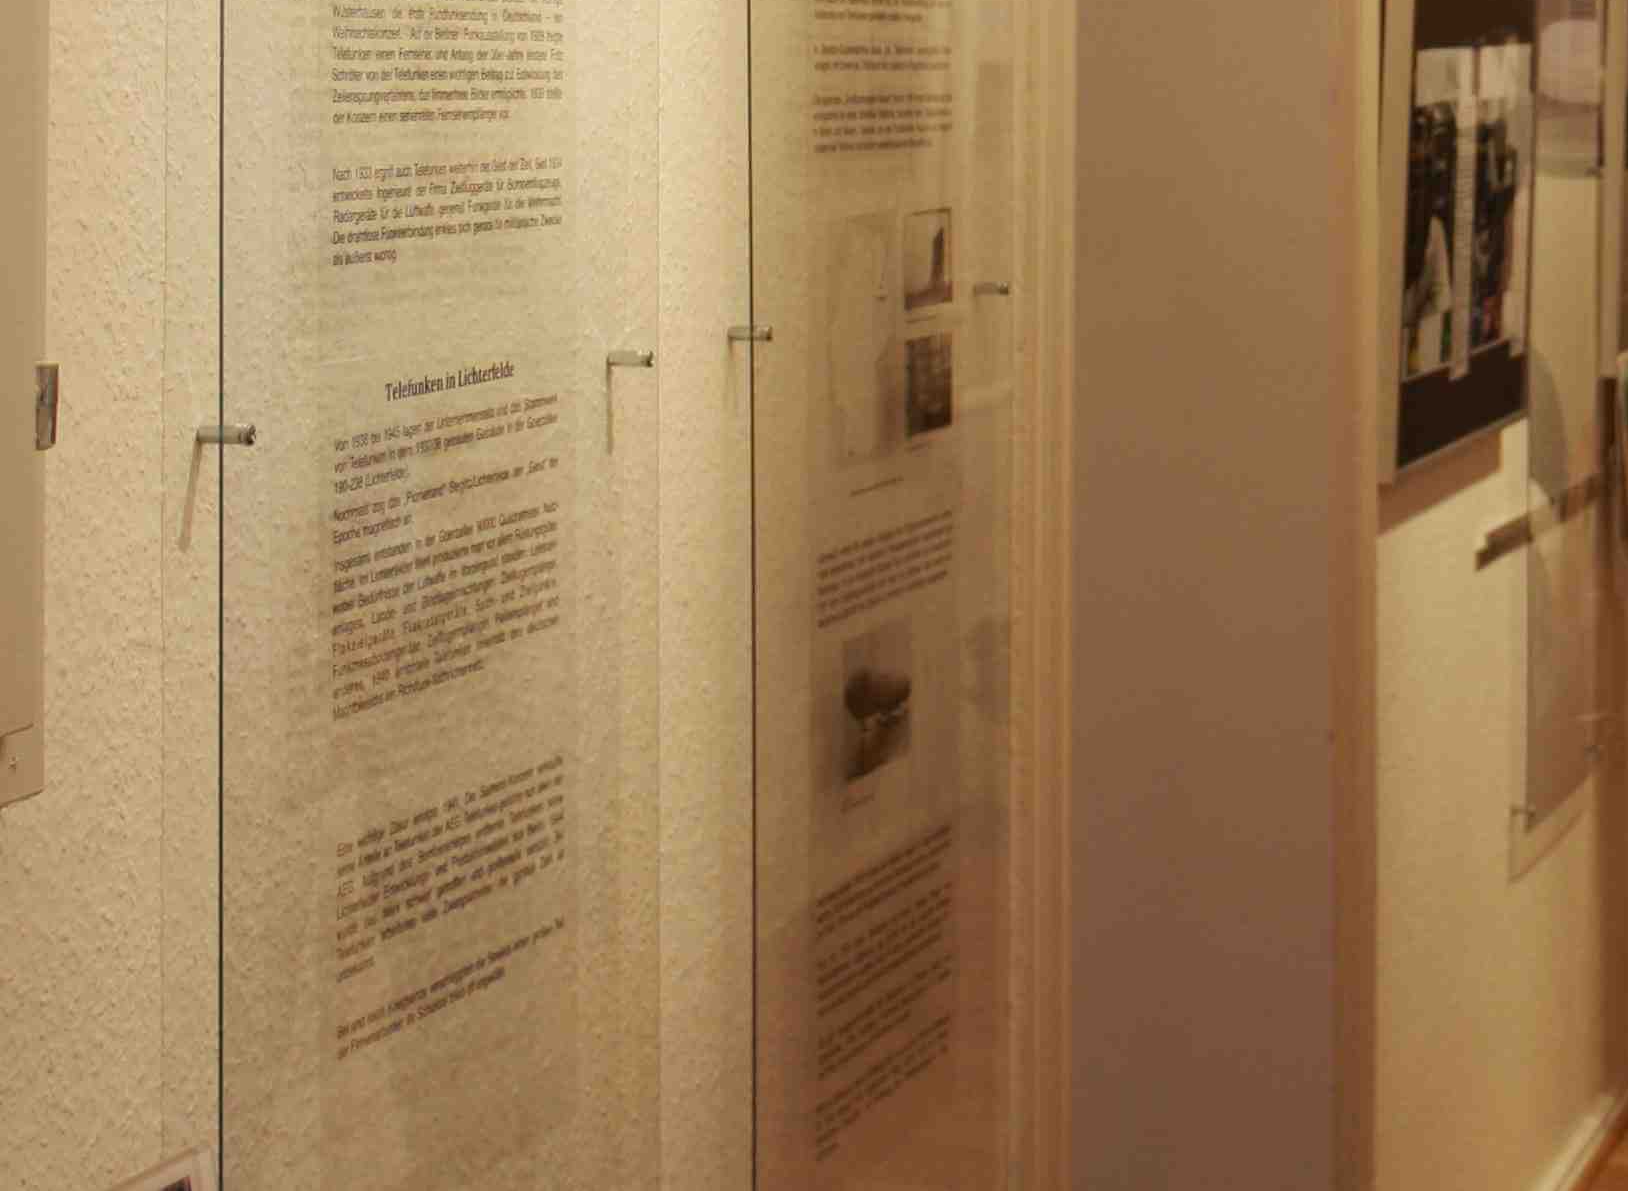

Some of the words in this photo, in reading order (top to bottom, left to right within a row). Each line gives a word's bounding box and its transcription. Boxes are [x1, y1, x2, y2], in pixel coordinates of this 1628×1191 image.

[385, 374, 444, 403] Telefunken
[445, 370, 456, 390] in
[457, 360, 516, 389] Lichterfelde
